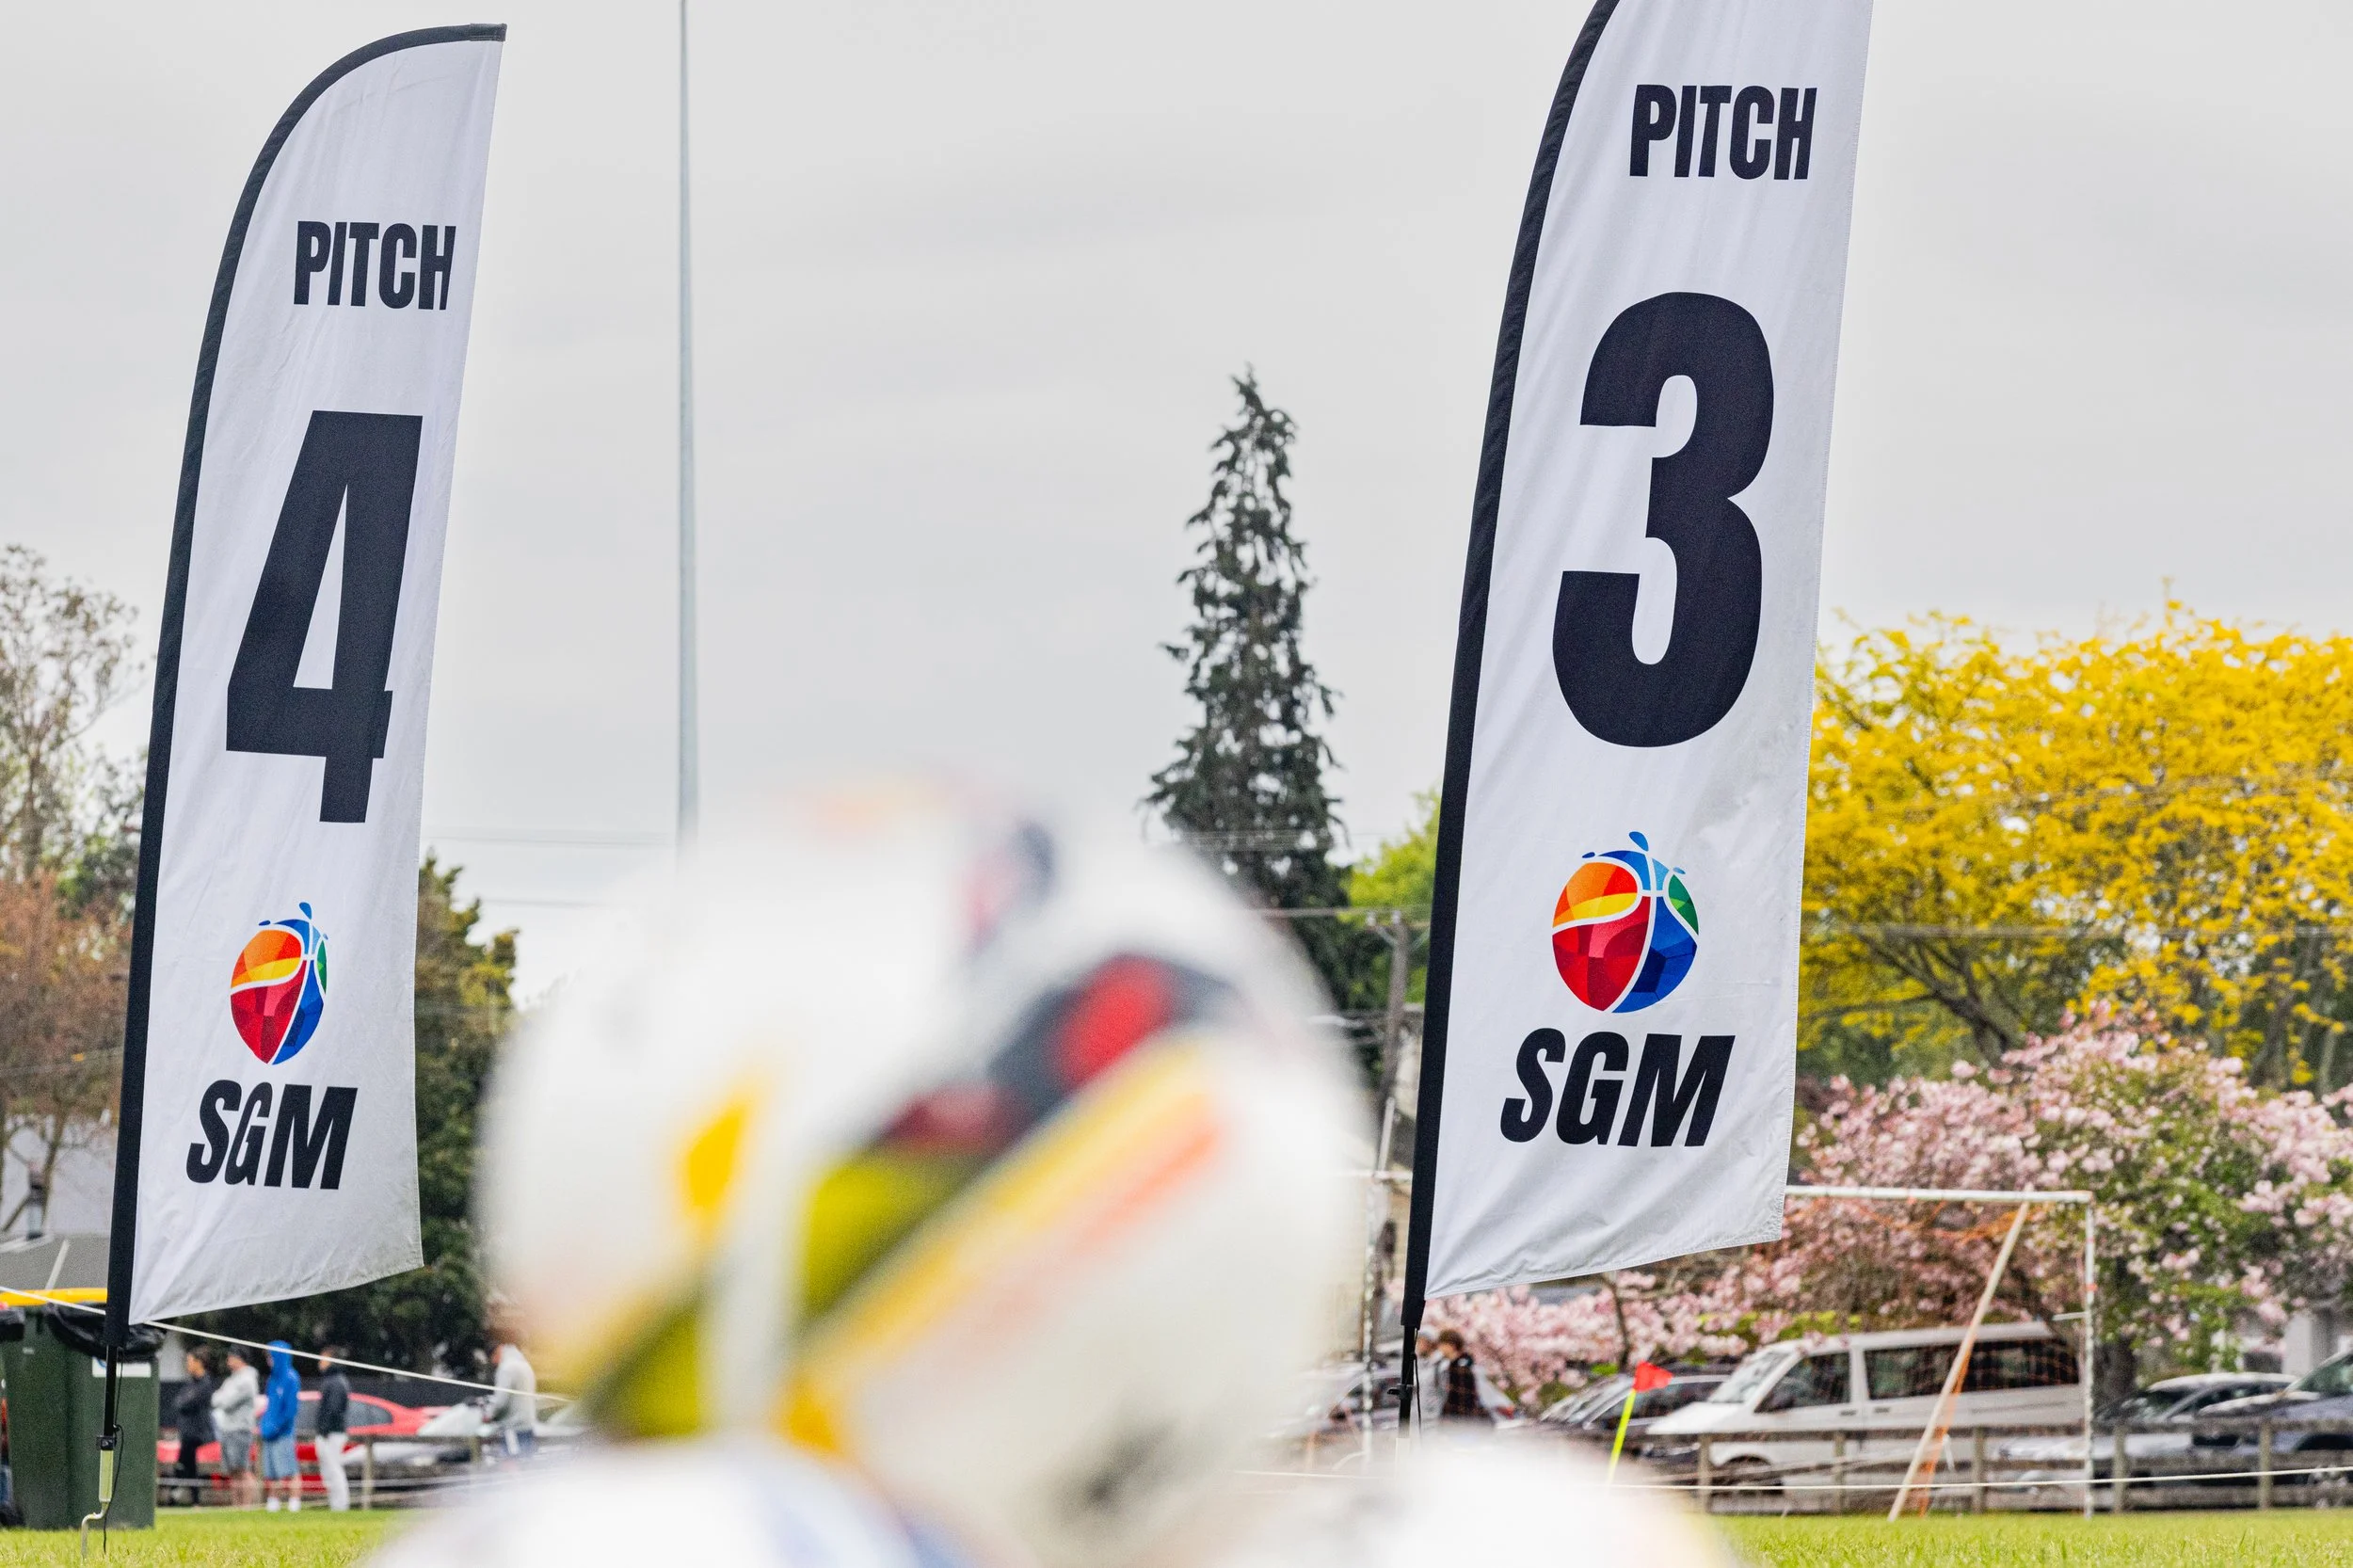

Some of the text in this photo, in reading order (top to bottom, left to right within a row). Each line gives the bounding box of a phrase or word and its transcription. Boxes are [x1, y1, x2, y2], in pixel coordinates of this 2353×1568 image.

[1630, 85, 1817, 181] PITCH
[294, 221, 456, 311] PITCH
[1553, 292, 1774, 748] 3
[226, 410, 424, 824] 4
[186, 1080, 359, 1191] SGM
[1500, 1029, 1736, 1147] SGM
